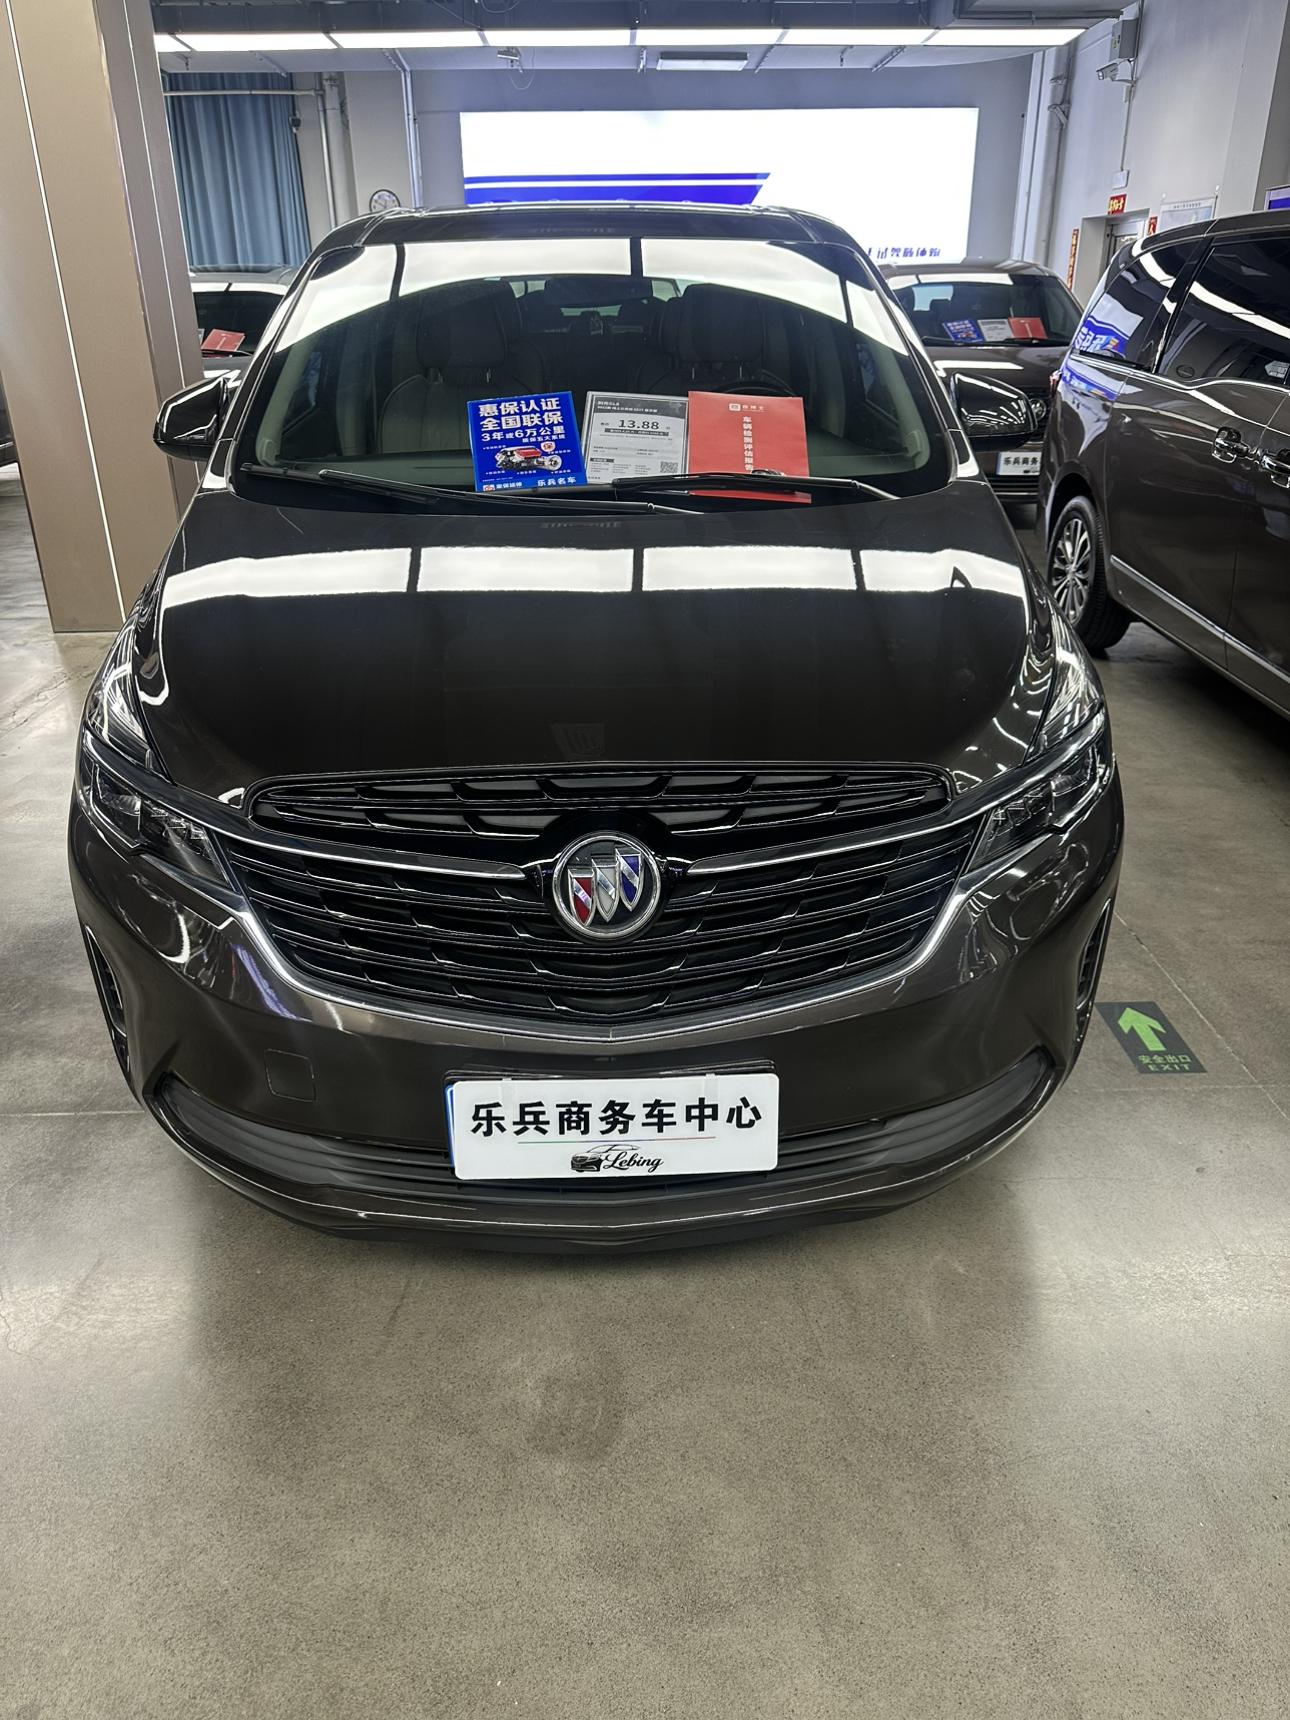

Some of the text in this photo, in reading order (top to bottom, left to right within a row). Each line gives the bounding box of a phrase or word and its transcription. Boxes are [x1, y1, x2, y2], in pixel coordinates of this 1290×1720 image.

[478, 397, 562, 417] 惠保认证
[480, 411, 564, 431] 全国联保
[618, 420, 660, 430] 13.88
[481, 425, 566, 442] 3年或6万公里
[743, 416, 754, 471] 车辆检测评估报告
[537, 476, 577, 487] 乐兵名车
[1138, 1054, 1192, 1064] 安全出口
[1147, 1064, 1190, 1072] EXIT
[471, 1096, 762, 1137] 乐兵商务车中心
[603, 1152, 664, 1173] Lebing
